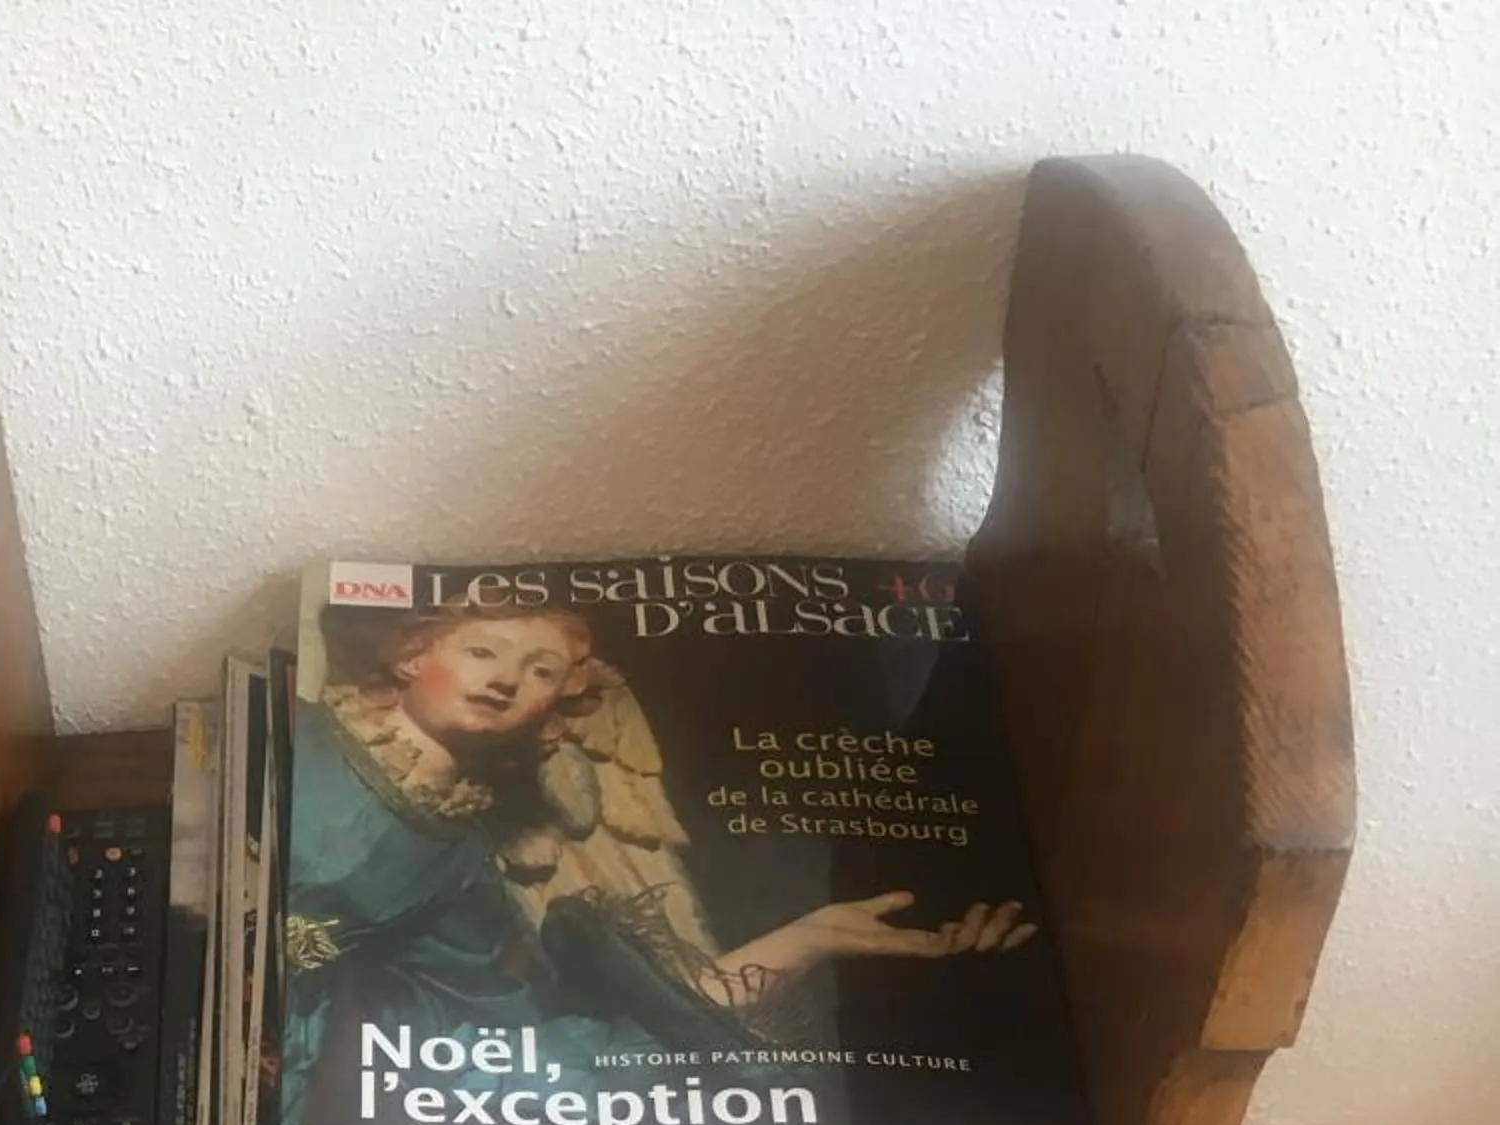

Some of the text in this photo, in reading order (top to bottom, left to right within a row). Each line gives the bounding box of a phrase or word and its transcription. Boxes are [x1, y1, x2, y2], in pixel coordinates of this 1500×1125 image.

[334, 580, 409, 599] DNA
[732, 726, 936, 757] La crèche
[759, 753, 919, 784] oubliée
[707, 785, 980, 815] de la cathédrale
[727, 813, 969, 847] de Strasbourg
[360, 1022, 563, 1083] Noël,
[595, 1050, 973, 1072] HISTOIRE PATRIMOINE CULTURE
